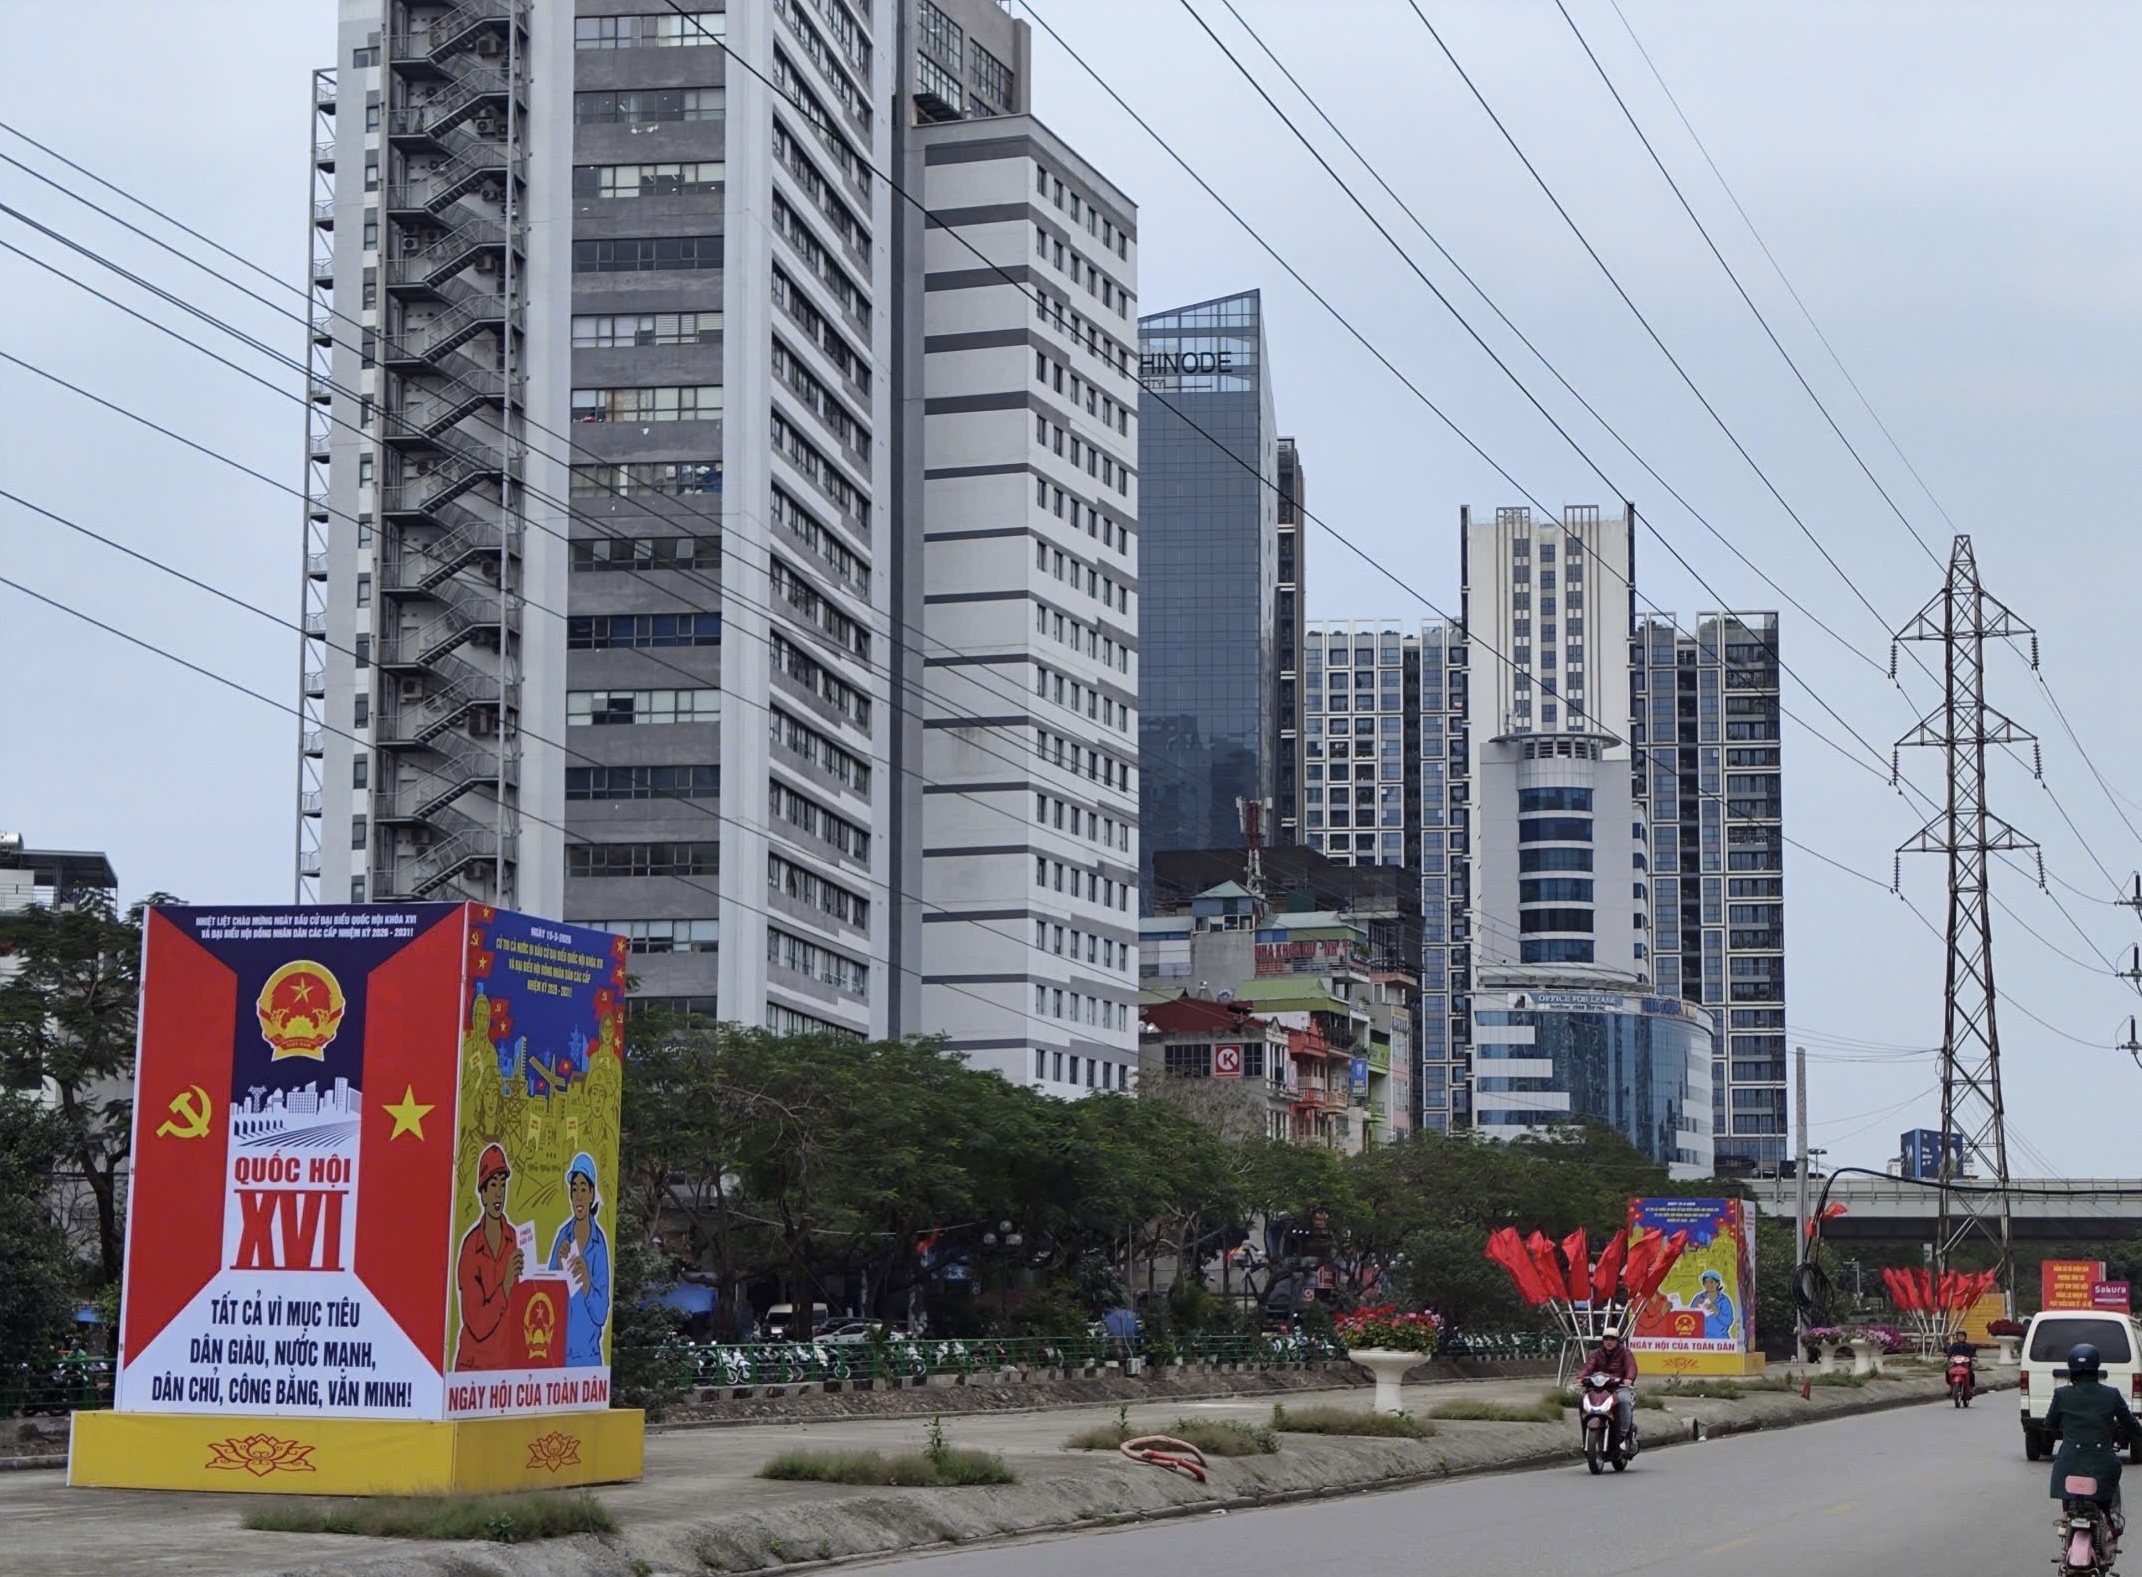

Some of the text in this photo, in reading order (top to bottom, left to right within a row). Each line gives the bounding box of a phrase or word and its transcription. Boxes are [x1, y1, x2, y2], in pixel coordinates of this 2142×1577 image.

[1139, 352, 1233, 374] HINODE
[405, 914, 417, 924] XVI
[234, 1149, 351, 1188] QUỐC HỘI
[230, 1189, 349, 1272] XVI
[2094, 1285, 2127, 1294] Sakura
[211, 1289, 360, 1333] TẤT CẢ VÌ MỤC TIÊU
[190, 1331, 376, 1373] DÂN GIÀU, NƯỚC MẠNH,
[1629, 1341, 1653, 1350] NGÀY
[1655, 1341, 1670, 1351] HỘI
[1672, 1339, 1689, 1350] CỦA
[152, 1367, 412, 1409] DÂN CHỦ, CÔNG BẰNG, VĂN MINH!
[448, 1374, 608, 1414] NGÀY HỘI CỦA TOÀN DÂN
